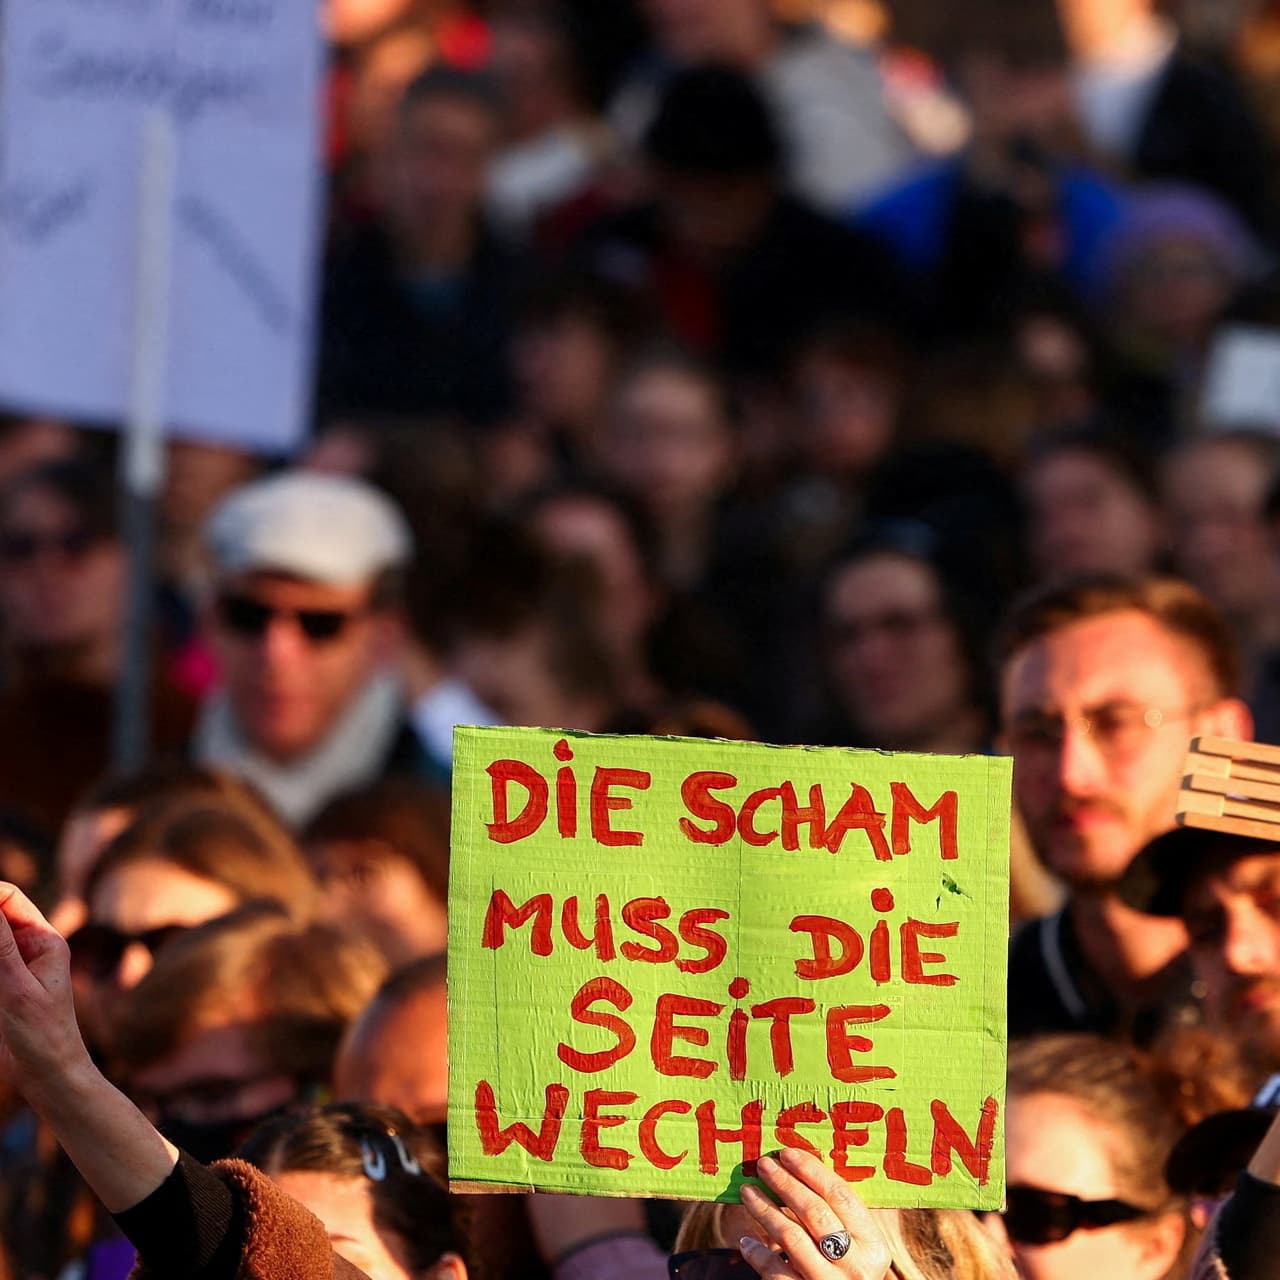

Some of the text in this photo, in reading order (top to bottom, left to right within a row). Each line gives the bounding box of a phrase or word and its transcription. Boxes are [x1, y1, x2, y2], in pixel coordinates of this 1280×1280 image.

[679, 771, 959, 861] SCHAM
[481, 889, 729, 974] MUSS
[475, 1080, 999, 1187] WECHSELN
